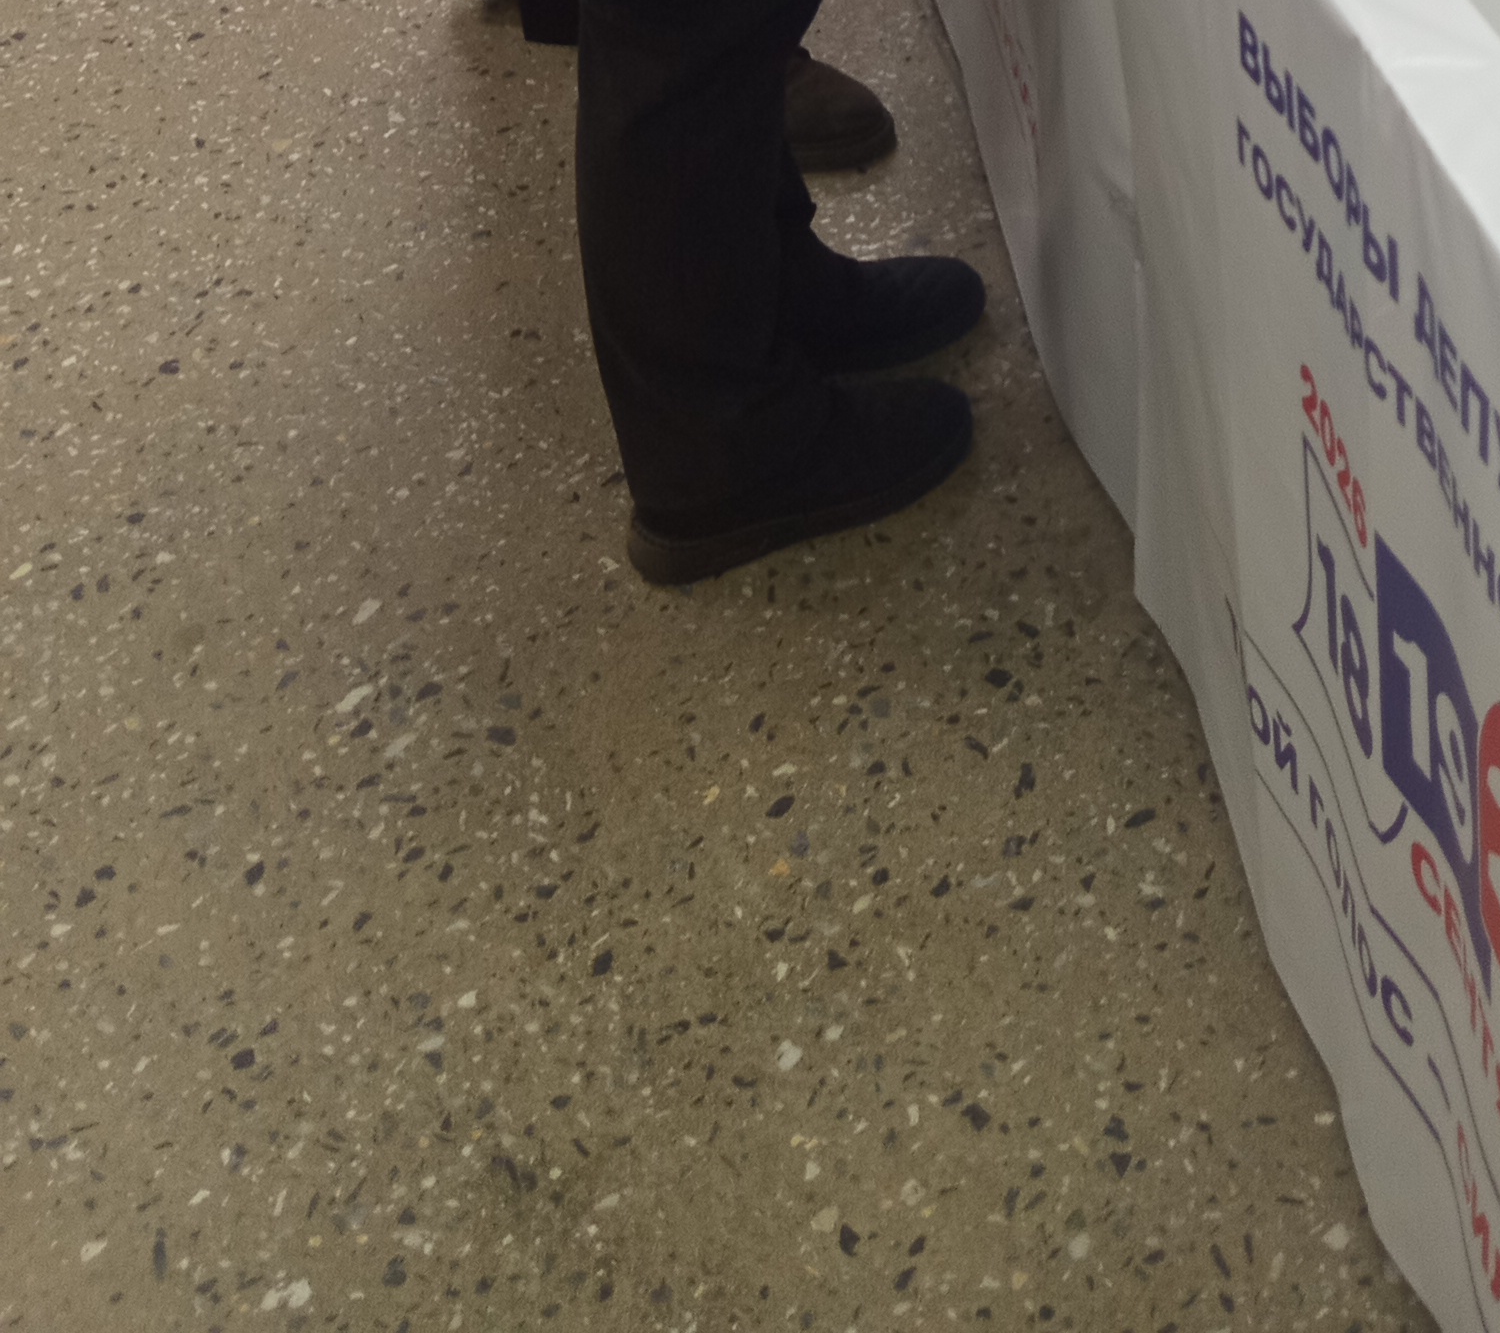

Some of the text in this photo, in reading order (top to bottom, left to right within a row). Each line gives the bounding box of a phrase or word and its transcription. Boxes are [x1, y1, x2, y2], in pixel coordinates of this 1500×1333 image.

[1238, 9, 1400, 304] ВЫБОРЫ
[1301, 363, 1367, 549] 2026
[1393, 630, 1474, 865] 19
[1309, 774, 1414, 1047] ГОЛОС
